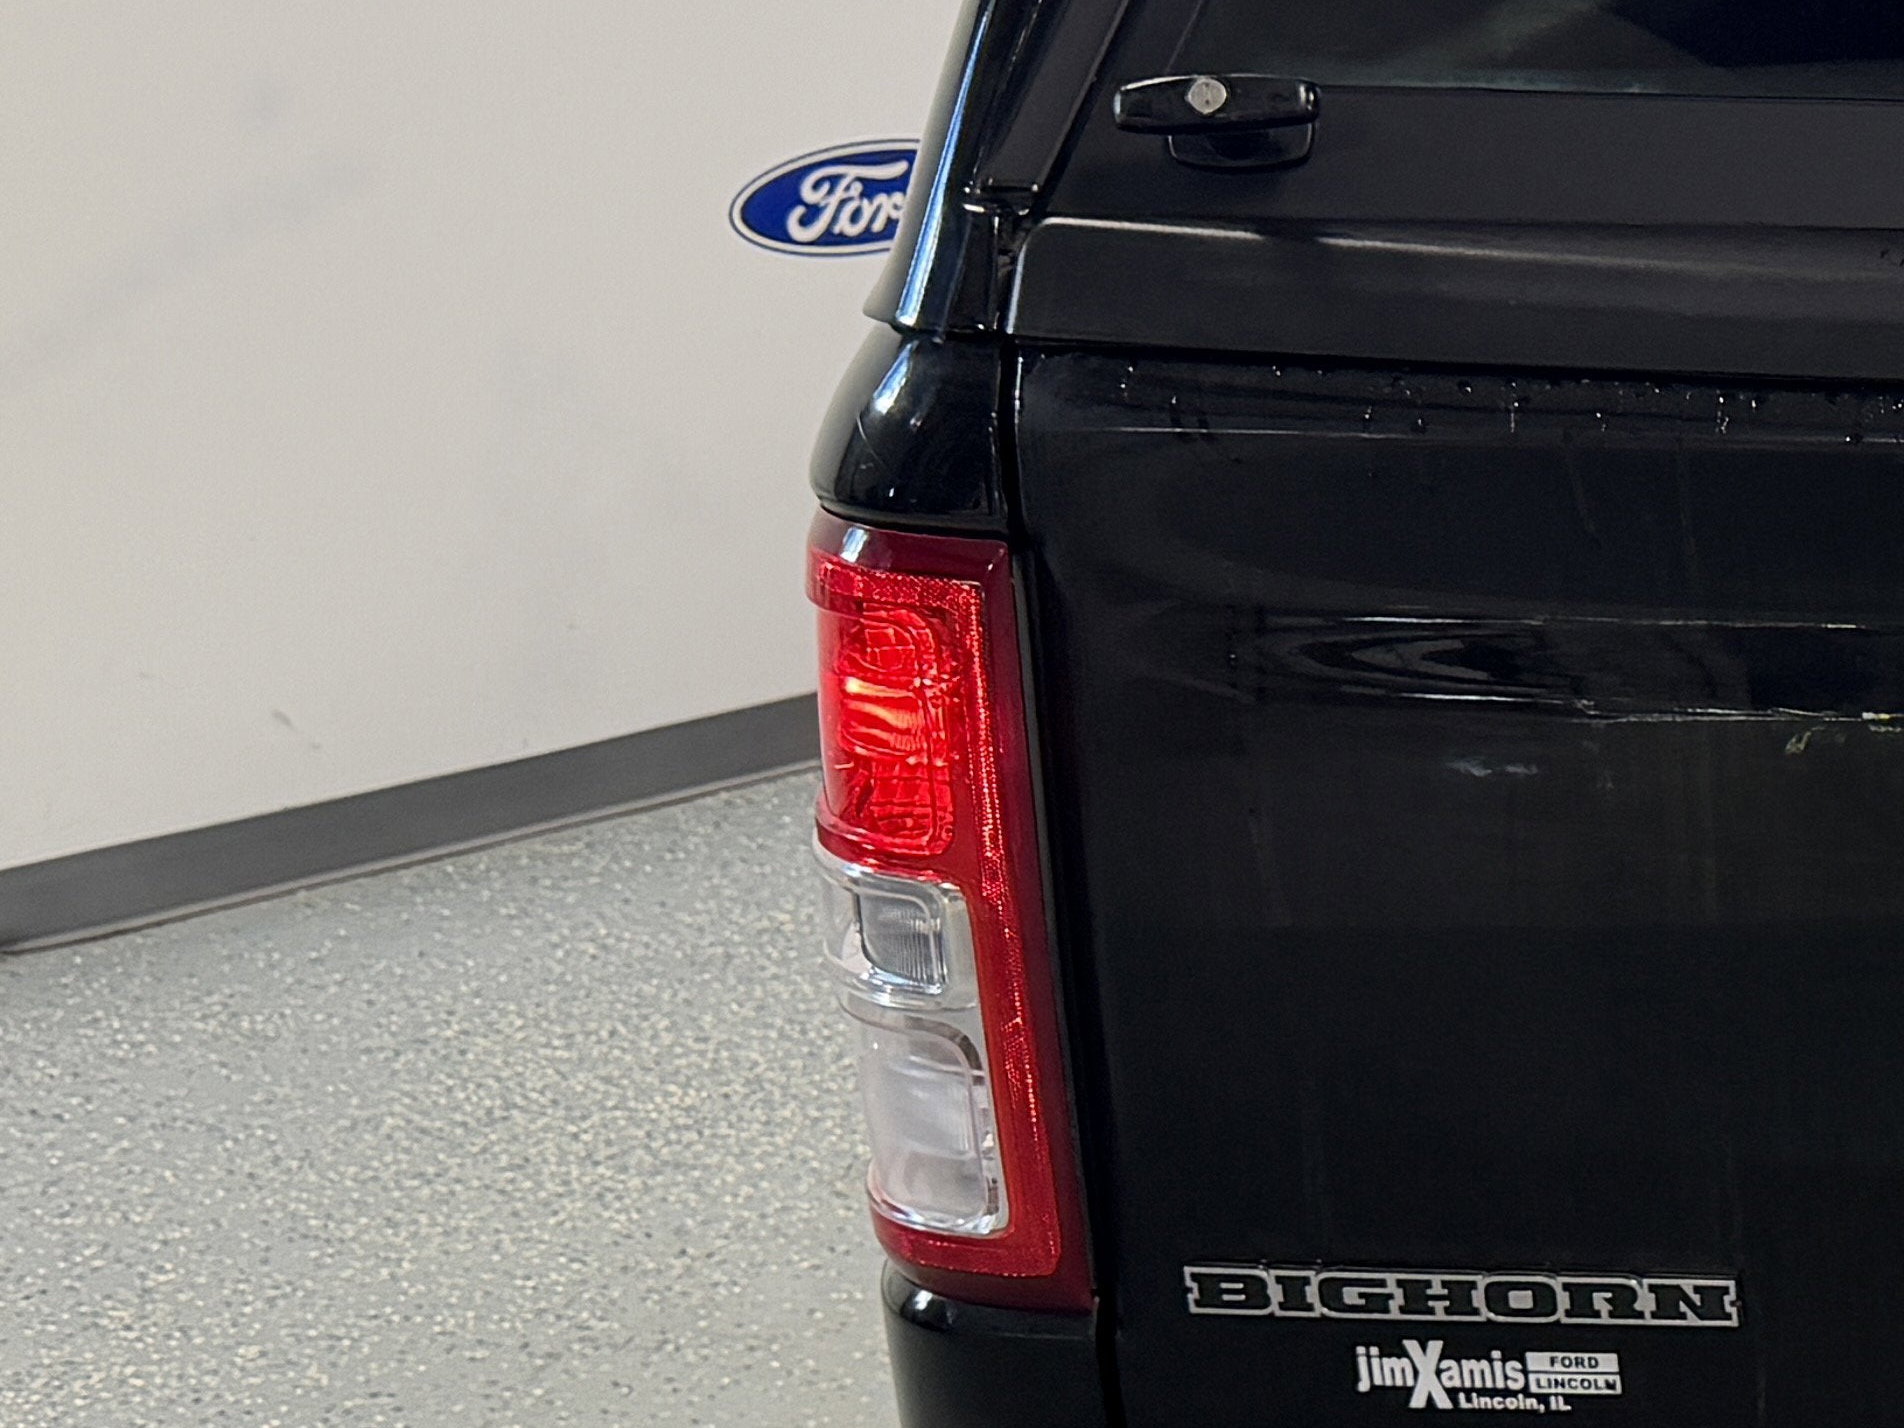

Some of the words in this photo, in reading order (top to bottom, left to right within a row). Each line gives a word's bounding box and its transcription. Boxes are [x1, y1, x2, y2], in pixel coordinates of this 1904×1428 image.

[787, 160, 908, 243] For
[1184, 1265, 1742, 1328] BIGHORN
[1549, 1355, 1600, 1370] FORD
[1535, 1376, 1617, 1392] LINCOLN
[1458, 1392, 1545, 1414] Lincoln,
[1549, 1395, 1572, 1412] IL
